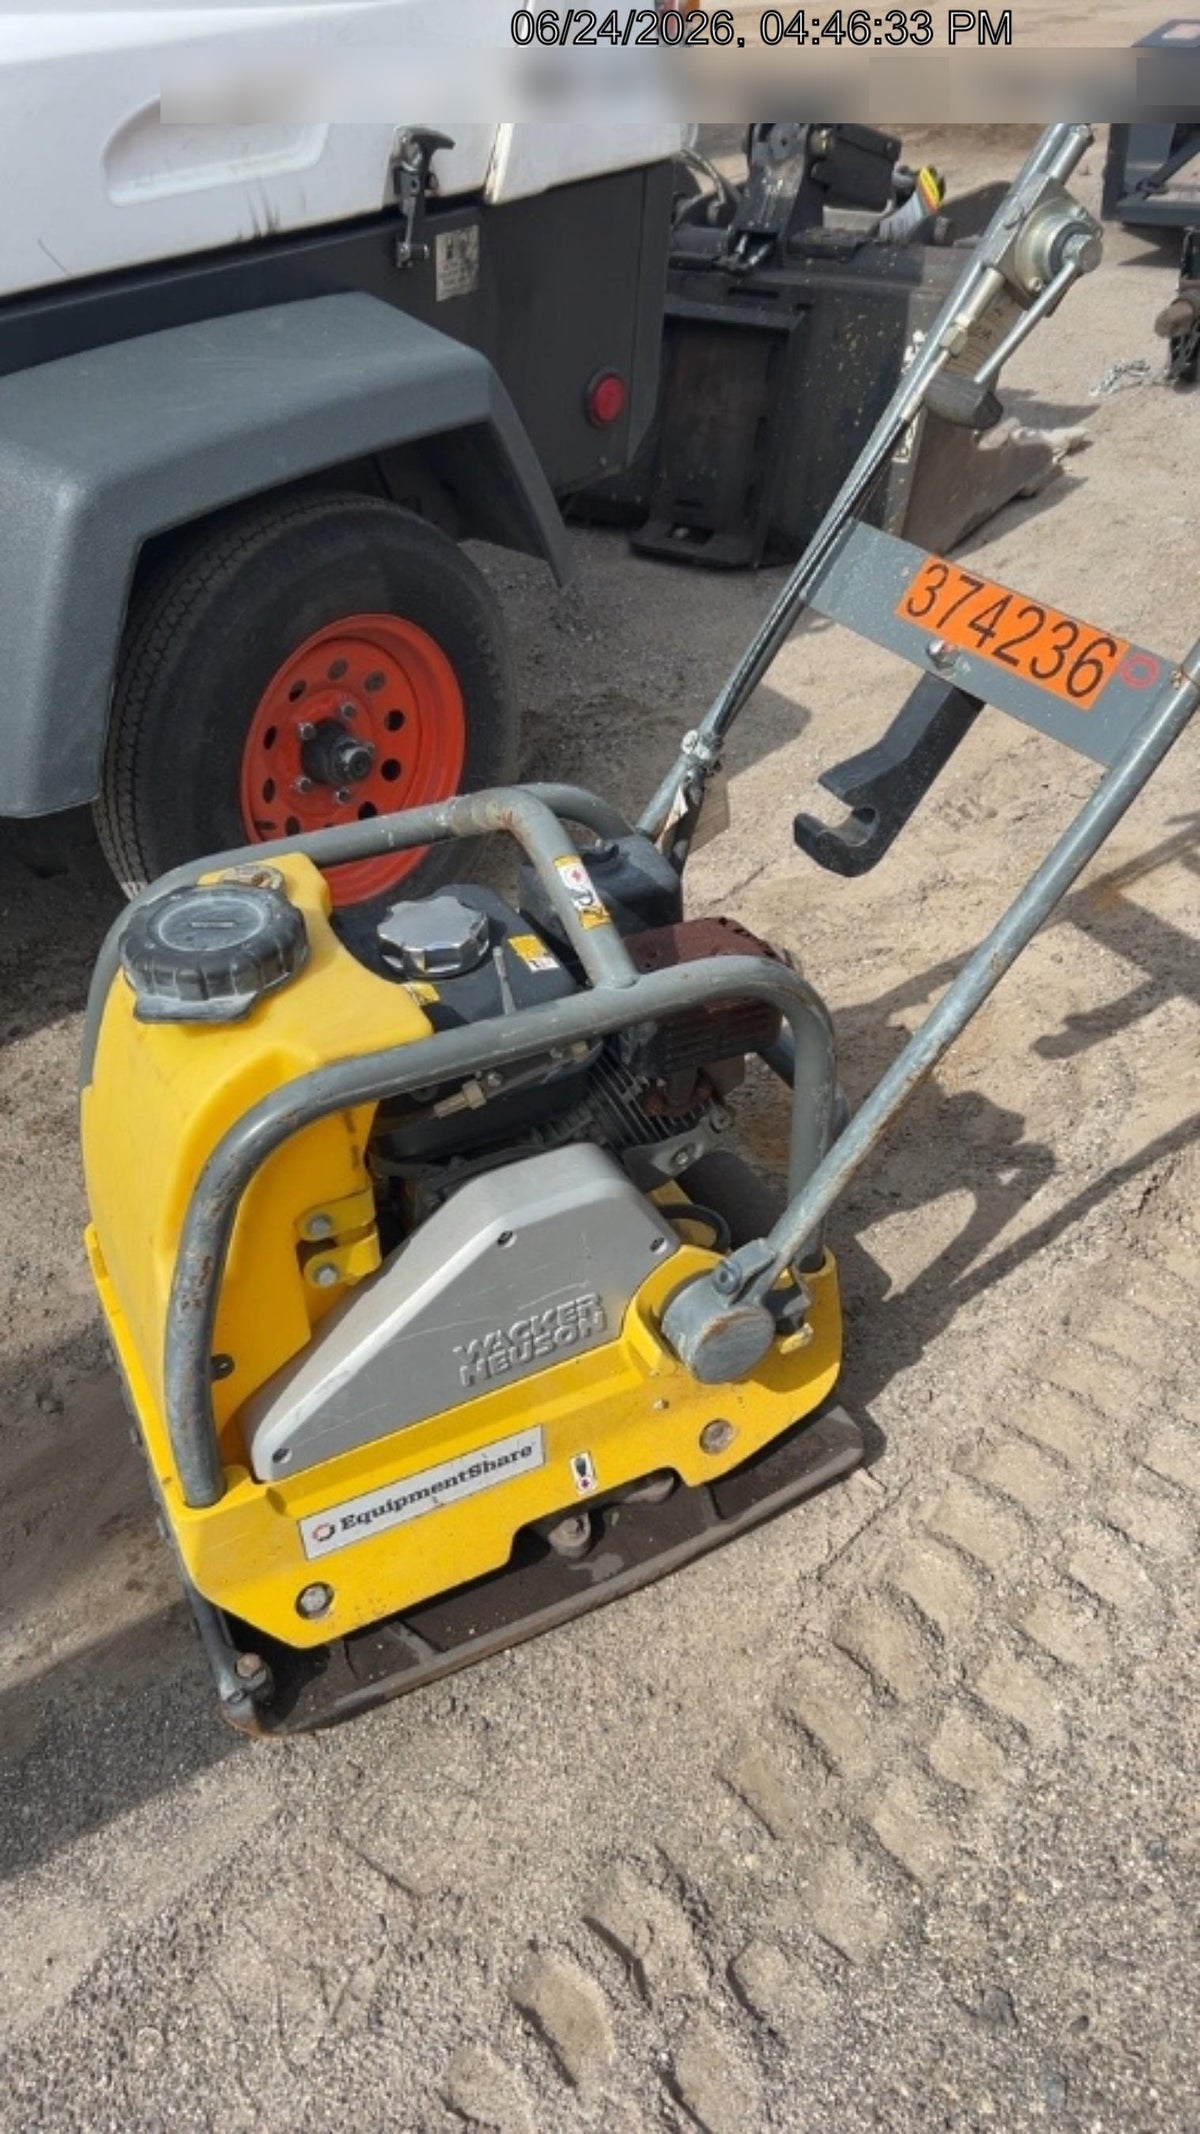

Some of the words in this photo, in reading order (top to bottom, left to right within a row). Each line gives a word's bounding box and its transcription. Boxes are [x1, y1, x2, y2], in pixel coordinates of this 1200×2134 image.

[905, 562, 1118, 699] 374236
[453, 1292, 602, 1365] WACKER
[458, 1308, 607, 1388] NEUSON
[340, 1444, 533, 1531] EquipmentShare
